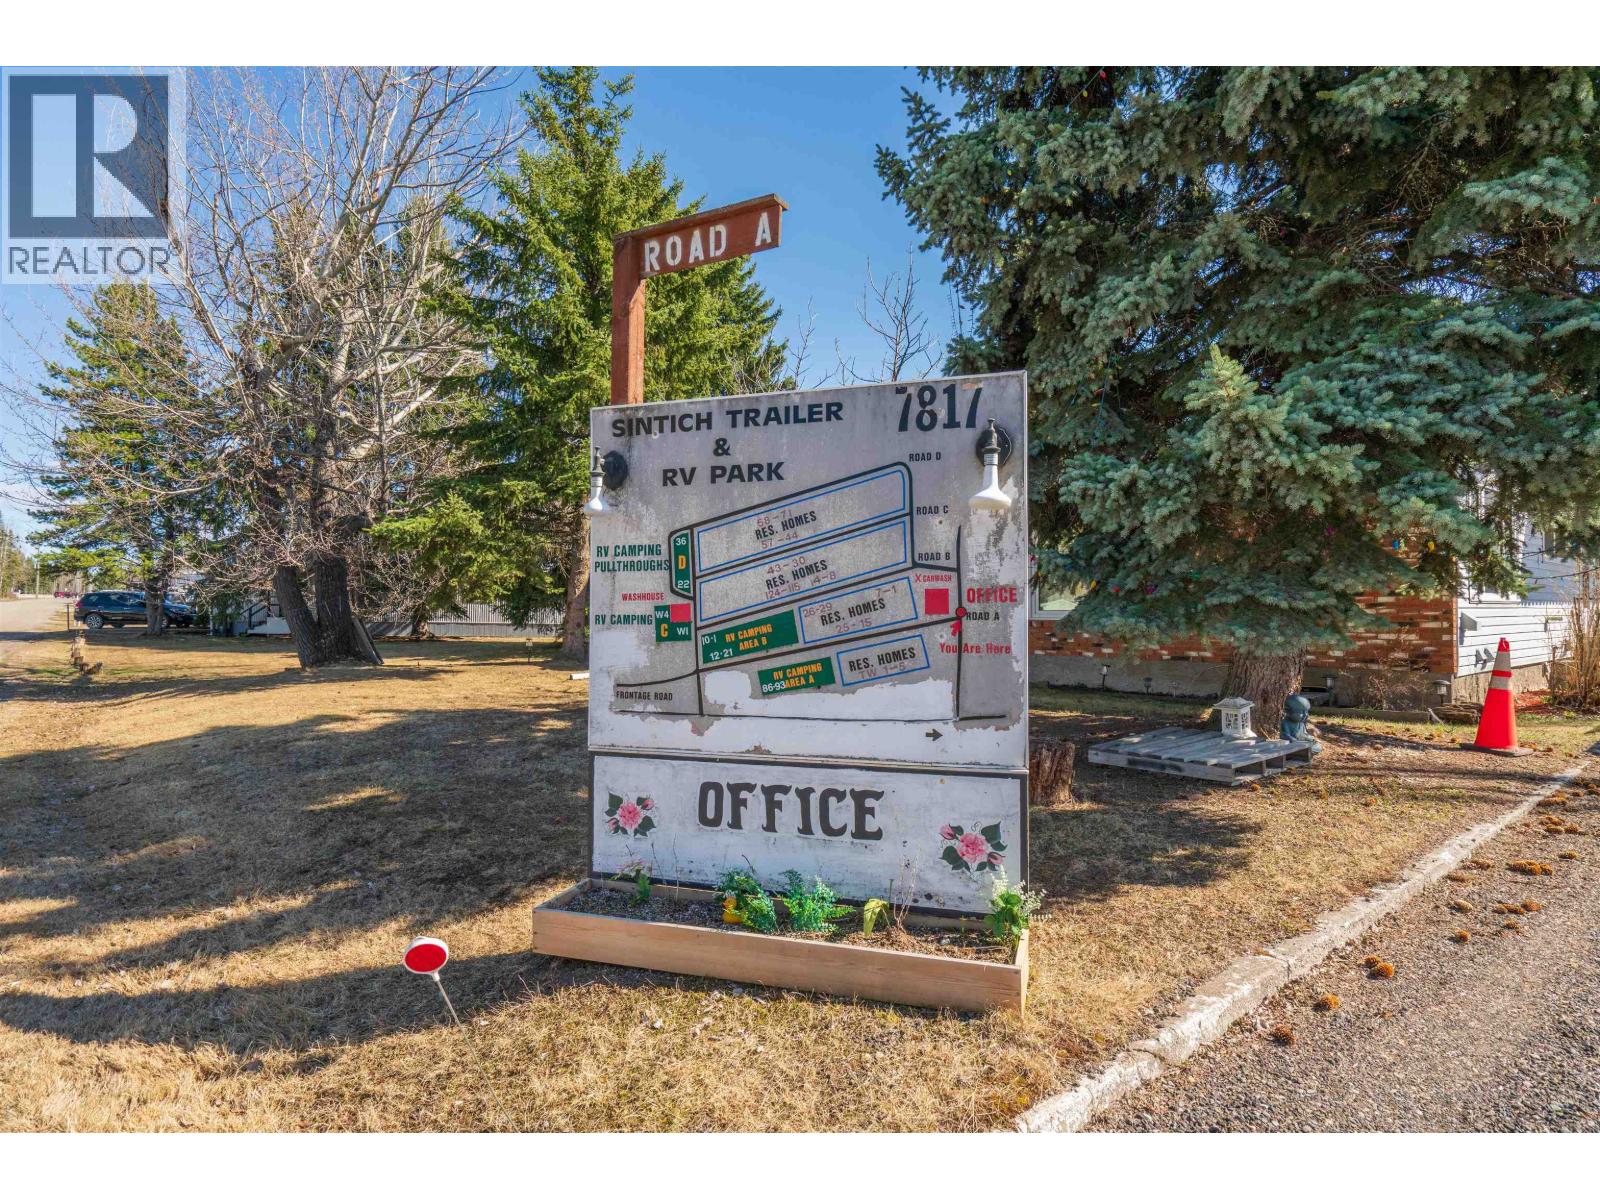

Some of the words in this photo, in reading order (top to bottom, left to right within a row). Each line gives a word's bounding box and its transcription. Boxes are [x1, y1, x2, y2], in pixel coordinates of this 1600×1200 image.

[644, 223, 727, 273] ROAD
[755, 211, 772, 246] A
[895, 383, 983, 432] 7817
[612, 411, 713, 438] SINTICH
[726, 401, 844, 429] TRAILER
[713, 437, 731, 457] &
[908, 453, 932, 462] ROAD
[935, 452, 942, 461] D
[662, 467, 697, 487] RV
[710, 461, 785, 485] PARK
[916, 506, 939, 515] ROAD
[943, 505, 949, 514] C
[755, 525, 778, 540] RES.
[781, 510, 817, 531] HOMES
[675, 537, 687, 546] 36
[597, 545, 609, 557] RV
[614, 544, 662, 557] CAMPING
[918, 552, 941, 561] ROAD
[945, 552, 951, 560] B
[594, 559, 671, 572] PULLTHROUGHS
[678, 555, 687, 570] D
[765, 574, 789, 591] RES.
[792, 559, 828, 581] HOMES
[923, 574, 952, 582] CARWASH
[678, 580, 690, 589] 22
[621, 592, 665, 601] WASHHOUSE
[966, 587, 1017, 603] OFFICE
[655, 611, 670, 619] W4
[820, 611, 845, 626] RES.
[848, 598, 886, 618] HOMES
[966, 612, 990, 620] ROAD
[993, 612, 999, 620] A
[595, 614, 606, 625] RV
[610, 614, 653, 625] CAMPING
[660, 623, 668, 637] C
[725, 633, 735, 642] RV
[738, 624, 772, 639] CAMPING
[739, 638, 760, 651] AREA
[761, 636, 767, 645] B
[940, 643, 958, 654] You
[963, 643, 980, 654] Are
[986, 643, 1011, 654] Here
[848, 657, 874, 672] RES.
[877, 647, 916, 665] HOMES
[773, 671, 784, 680] RV
[786, 663, 822, 678] CAMPING
[785, 677, 806, 688] AREA
[808, 675, 815, 683] A
[616, 690, 651, 700] FRONTAGE
[654, 692, 673, 700] ROAD
[698, 781, 885, 841] OFFICE
